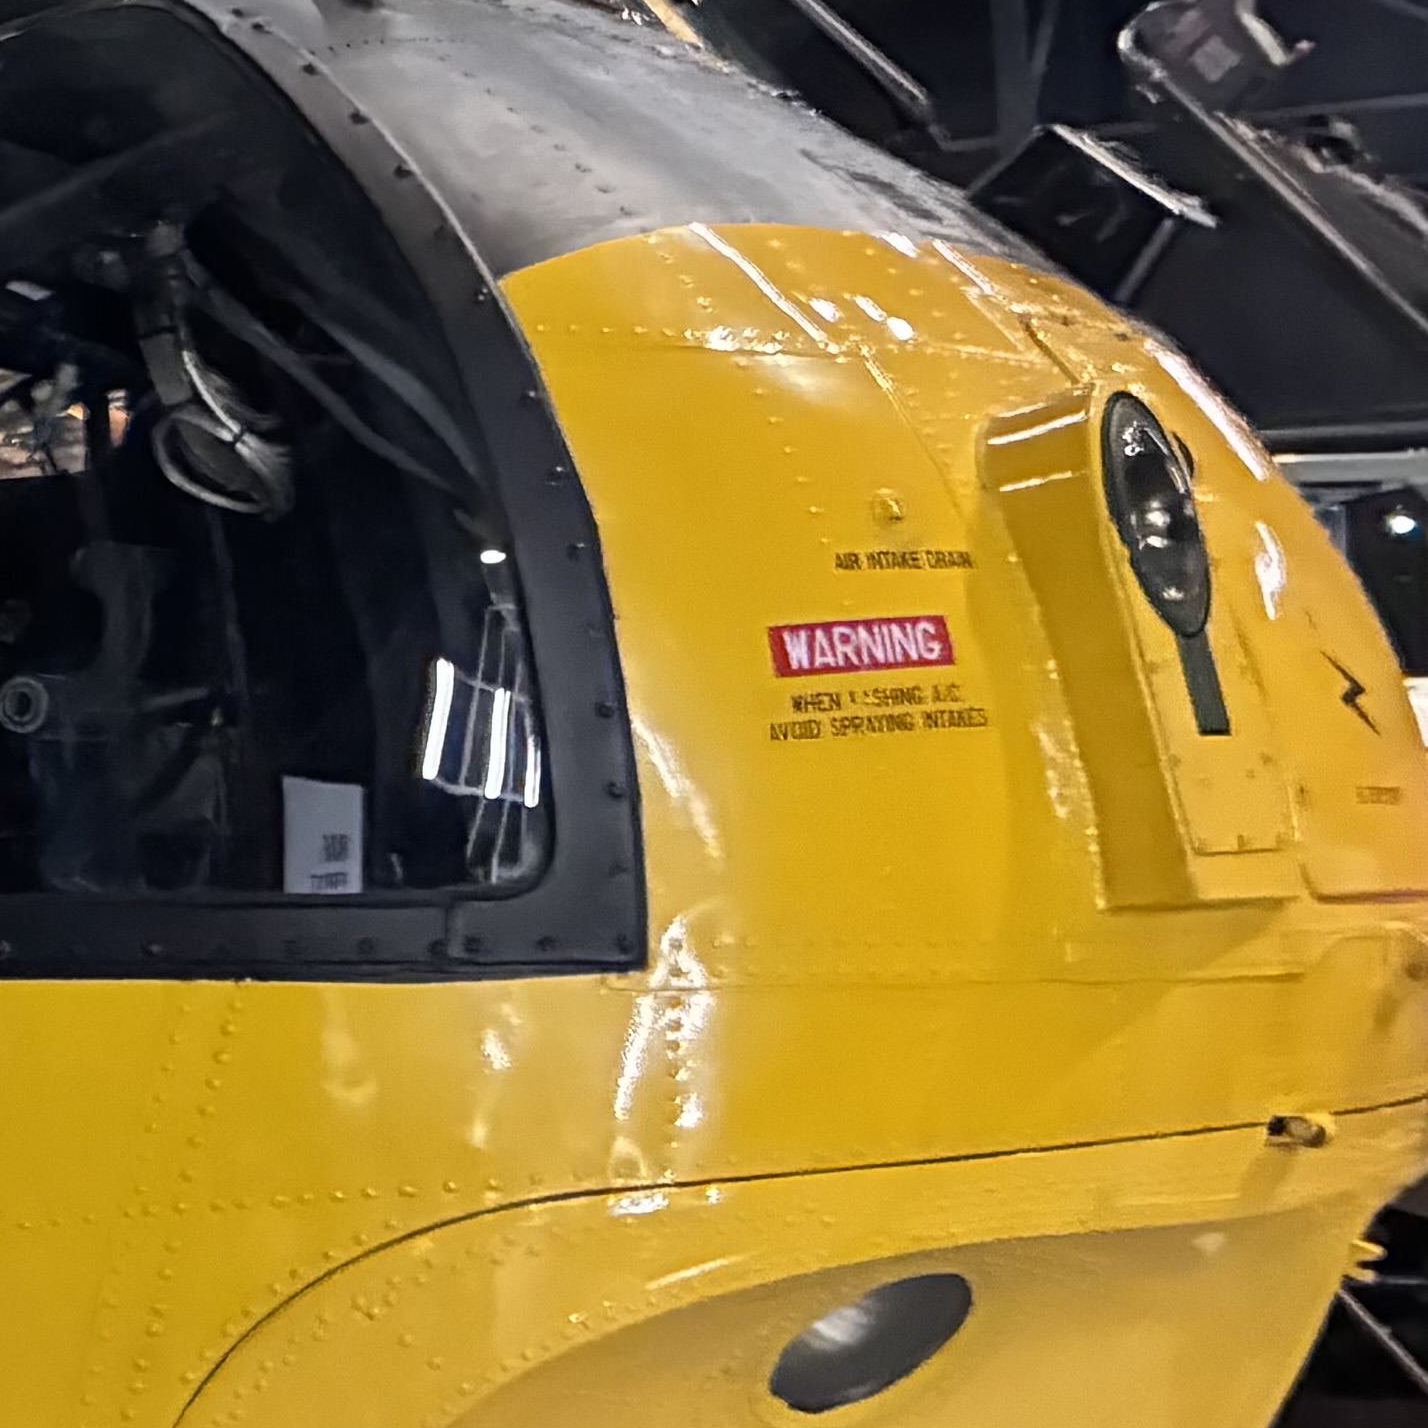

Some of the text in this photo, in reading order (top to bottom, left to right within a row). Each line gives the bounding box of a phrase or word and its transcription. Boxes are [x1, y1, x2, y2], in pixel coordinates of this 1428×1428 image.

[834, 551, 862, 570] AIR
[866, 550, 923, 570] INTAKE
[782, 621, 944, 670] WARNING
[791, 691, 842, 712] WHEN
[770, 705, 988, 740] AVOID SPRAYING INTAKES
